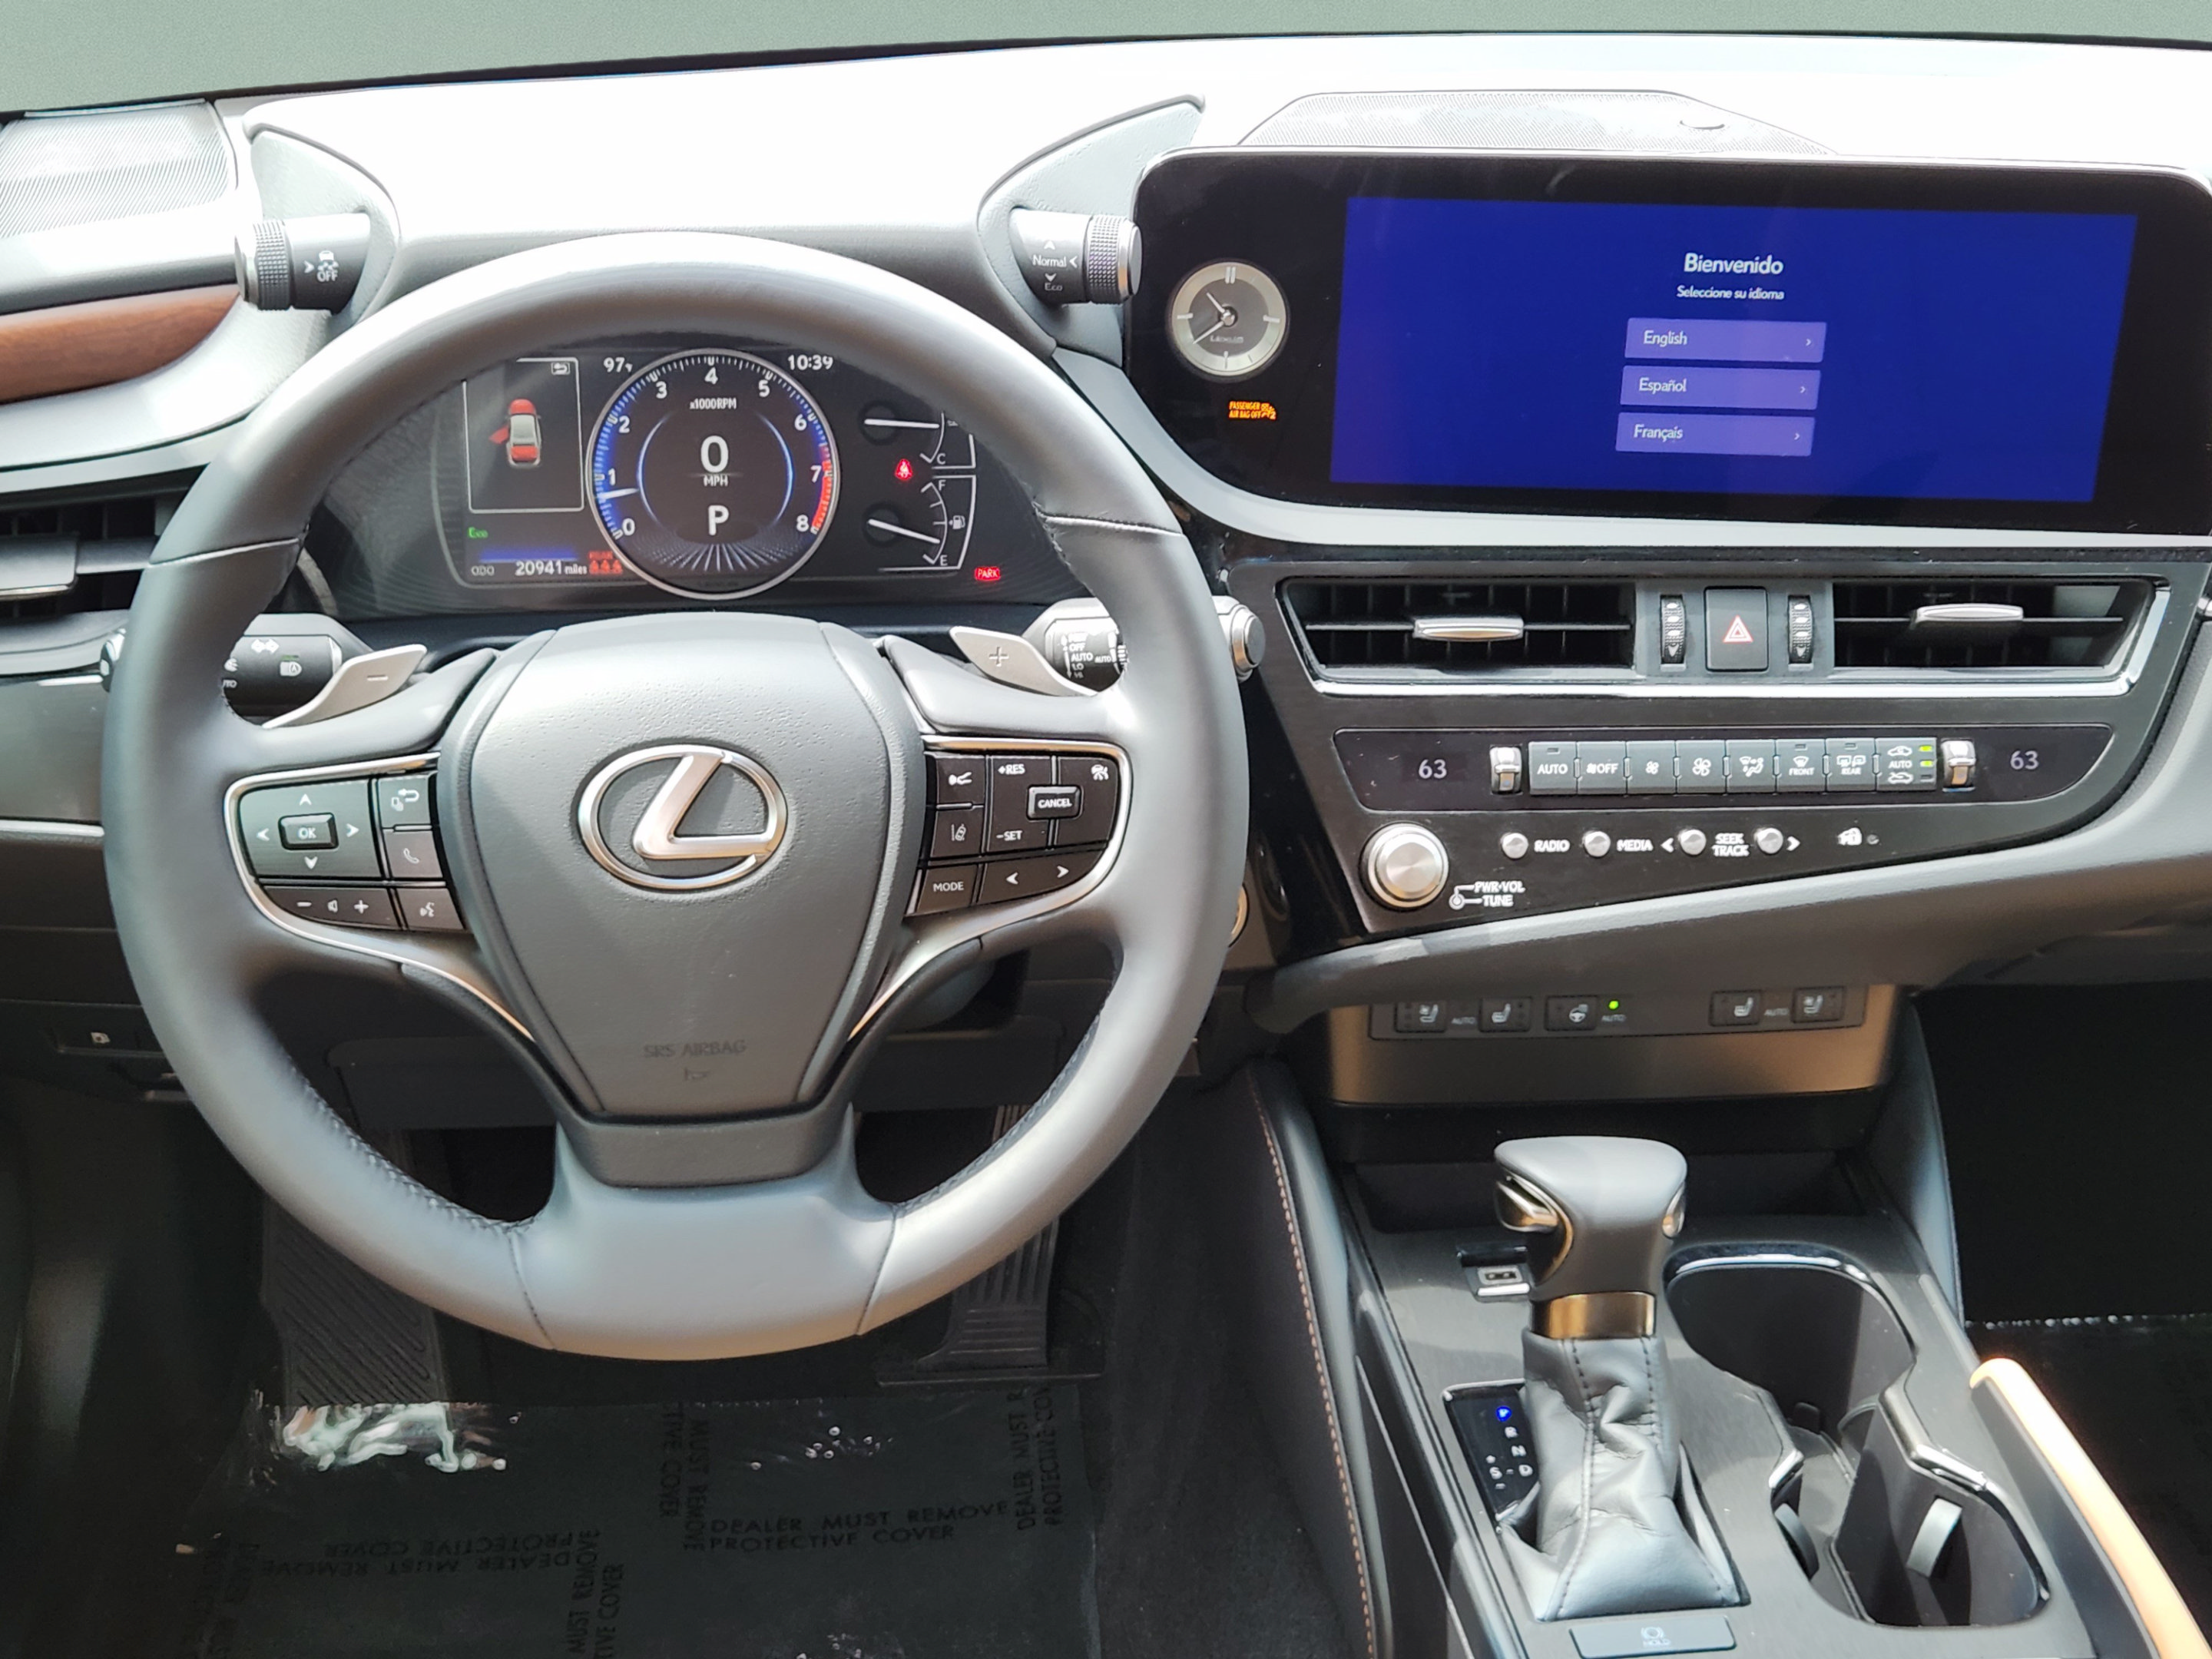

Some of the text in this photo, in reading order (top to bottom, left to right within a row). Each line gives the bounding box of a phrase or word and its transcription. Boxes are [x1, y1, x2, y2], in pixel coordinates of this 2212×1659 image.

[1032, 254, 1067, 267] Normal
[1684, 252, 1784, 275] Bienvenido
[316, 270, 338, 282] OFF
[1045, 283, 1063, 291] Eco
[1677, 285, 1784, 300] Seleccione su idioma
[1644, 329, 1687, 347] English
[787, 354, 834, 370] 10:39
[704, 367, 718, 385] 4
[656, 381, 667, 399] 3
[758, 379, 770, 397] 5
[1639, 377, 1687, 395] Español
[619, 416, 631, 434] 2
[794, 414, 807, 431] 6
[1634, 424, 1684, 442] Français
[700, 435, 730, 473] 0
[937, 453, 946, 465] C
[608, 469, 616, 485] 1
[704, 475, 728, 488] MPH
[810, 465, 822, 483] 7
[938, 480, 946, 491] F
[622, 518, 636, 536] 0
[708, 505, 730, 535] P
[796, 514, 809, 532] 8
[515, 560, 588, 576] 20941 miles
[940, 555, 948, 566] E
[471, 565, 495, 576] ODO
[976, 568, 999, 578] PARK
[1068, 643, 1085, 651] OFF
[1071, 652, 1094, 661] AUTO
[1071, 662, 1084, 671] LO
[1888, 759, 1912, 769] AUTO
[2010, 750, 2039, 770] 63
[1418, 759, 1448, 780] 63
[1537, 763, 1568, 775] AUTO
[1596, 762, 1618, 774] OFF
[1788, 767, 1814, 777] FRONT
[1038, 798, 1072, 808] CANCEL
[298, 828, 317, 839] OK
[1714, 833, 1744, 845] SEEK
[1534, 839, 1571, 853] RADIO
[1617, 839, 1654, 853] MEDIA
[1713, 845, 1750, 857] TRACK
[933, 881, 965, 892] MODE
[1482, 894, 1514, 907] TUNE
[1601, 1014, 1627, 1022] AUTO
[1764, 1008, 1790, 1016] AUTO
[644, 1039, 746, 1058] SRS AIRBAG
[1008, 1412, 1035, 1459] MUST
[1505, 1426, 1518, 1439] R
[1511, 1445, 1527, 1457] N
[1518, 1464, 1533, 1477] D
[1013, 1469, 1036, 1530] DEALER
[710, 1500, 1008, 1535] DEALER MUST REMOVE
[710, 1524, 955, 1553] PROTECTIVE COVER
[323, 1540, 409, 1559] COVER
[386, 1557, 460, 1576] MUST
[476, 1550, 571, 1571] DEALER
[597, 1563, 624, 1619] COVER
[565, 1610, 590, 1654] MUST
